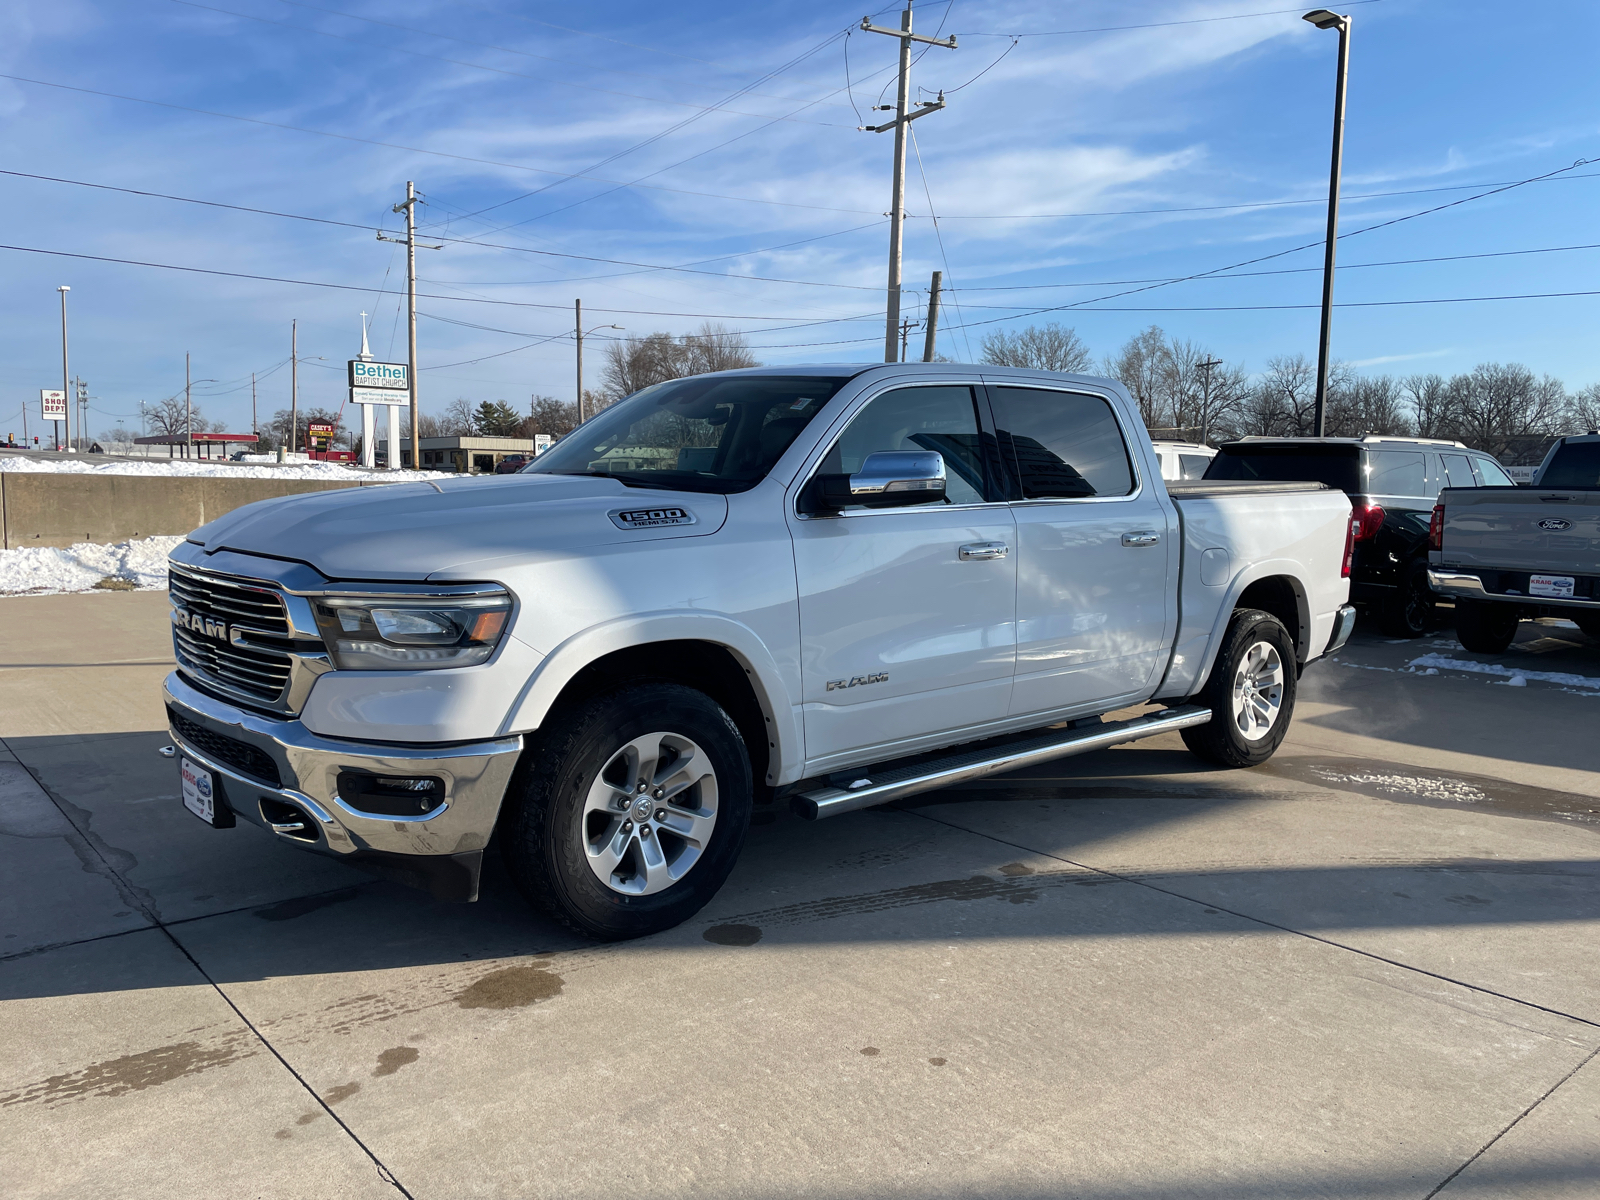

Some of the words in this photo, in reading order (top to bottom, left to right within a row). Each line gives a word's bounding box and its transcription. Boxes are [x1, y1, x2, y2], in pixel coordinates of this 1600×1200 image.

[355, 363, 405, 379] Bethel
[355, 376, 380, 386] BAPTIST
[381, 378, 406, 387] CHURCH
[623, 509, 682, 521] 1500
[1542, 520, 1566, 529] Ford
[174, 608, 228, 641] RAM
[826, 671, 889, 691] RAM
